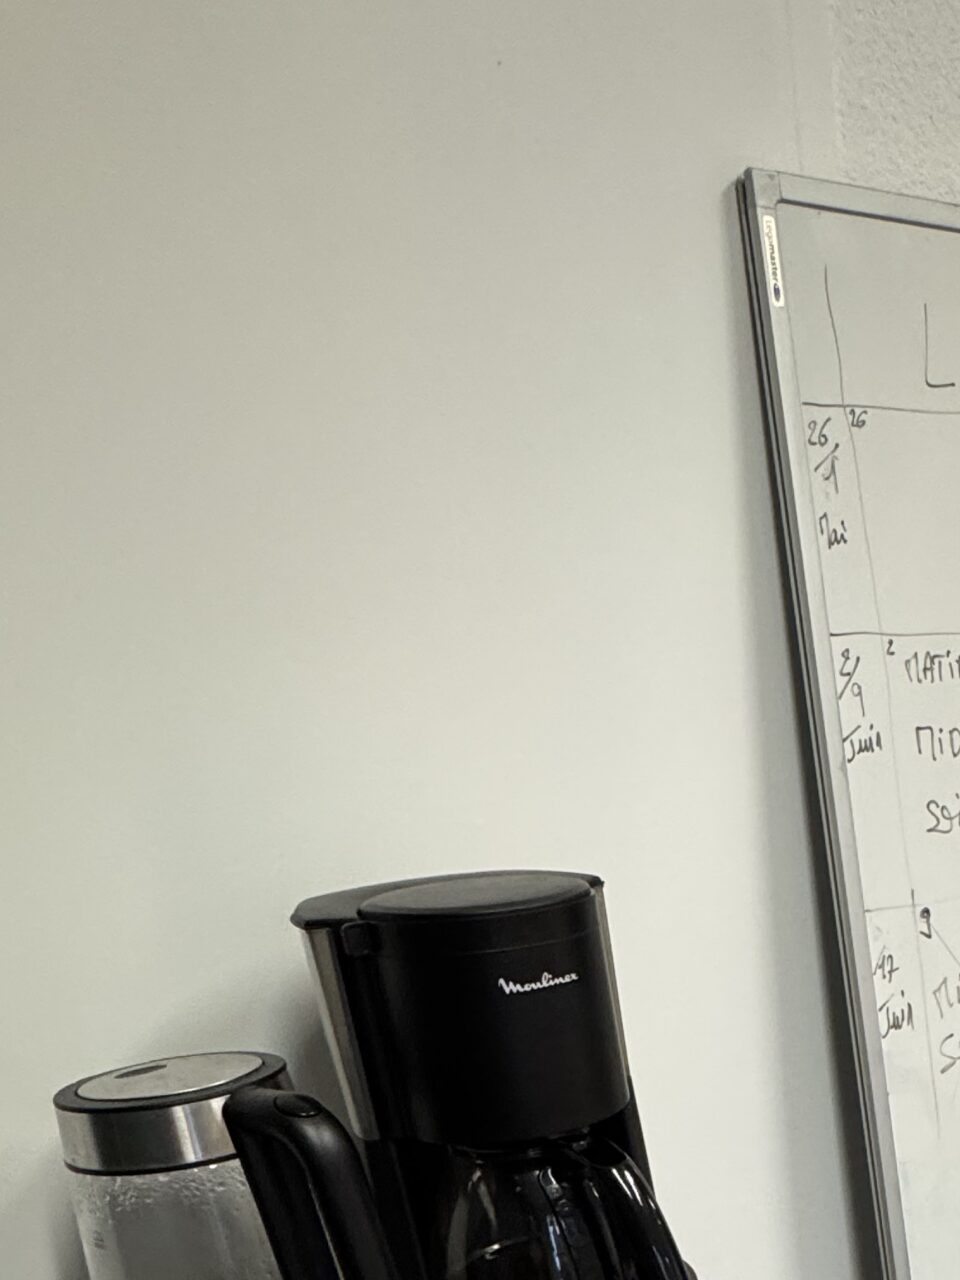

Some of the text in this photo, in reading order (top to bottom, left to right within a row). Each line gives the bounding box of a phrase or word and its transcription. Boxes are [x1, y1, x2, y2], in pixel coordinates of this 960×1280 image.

[922, 303, 956, 388] L
[849, 408, 868, 428] 26
[498, 971, 579, 995] Moulinex
